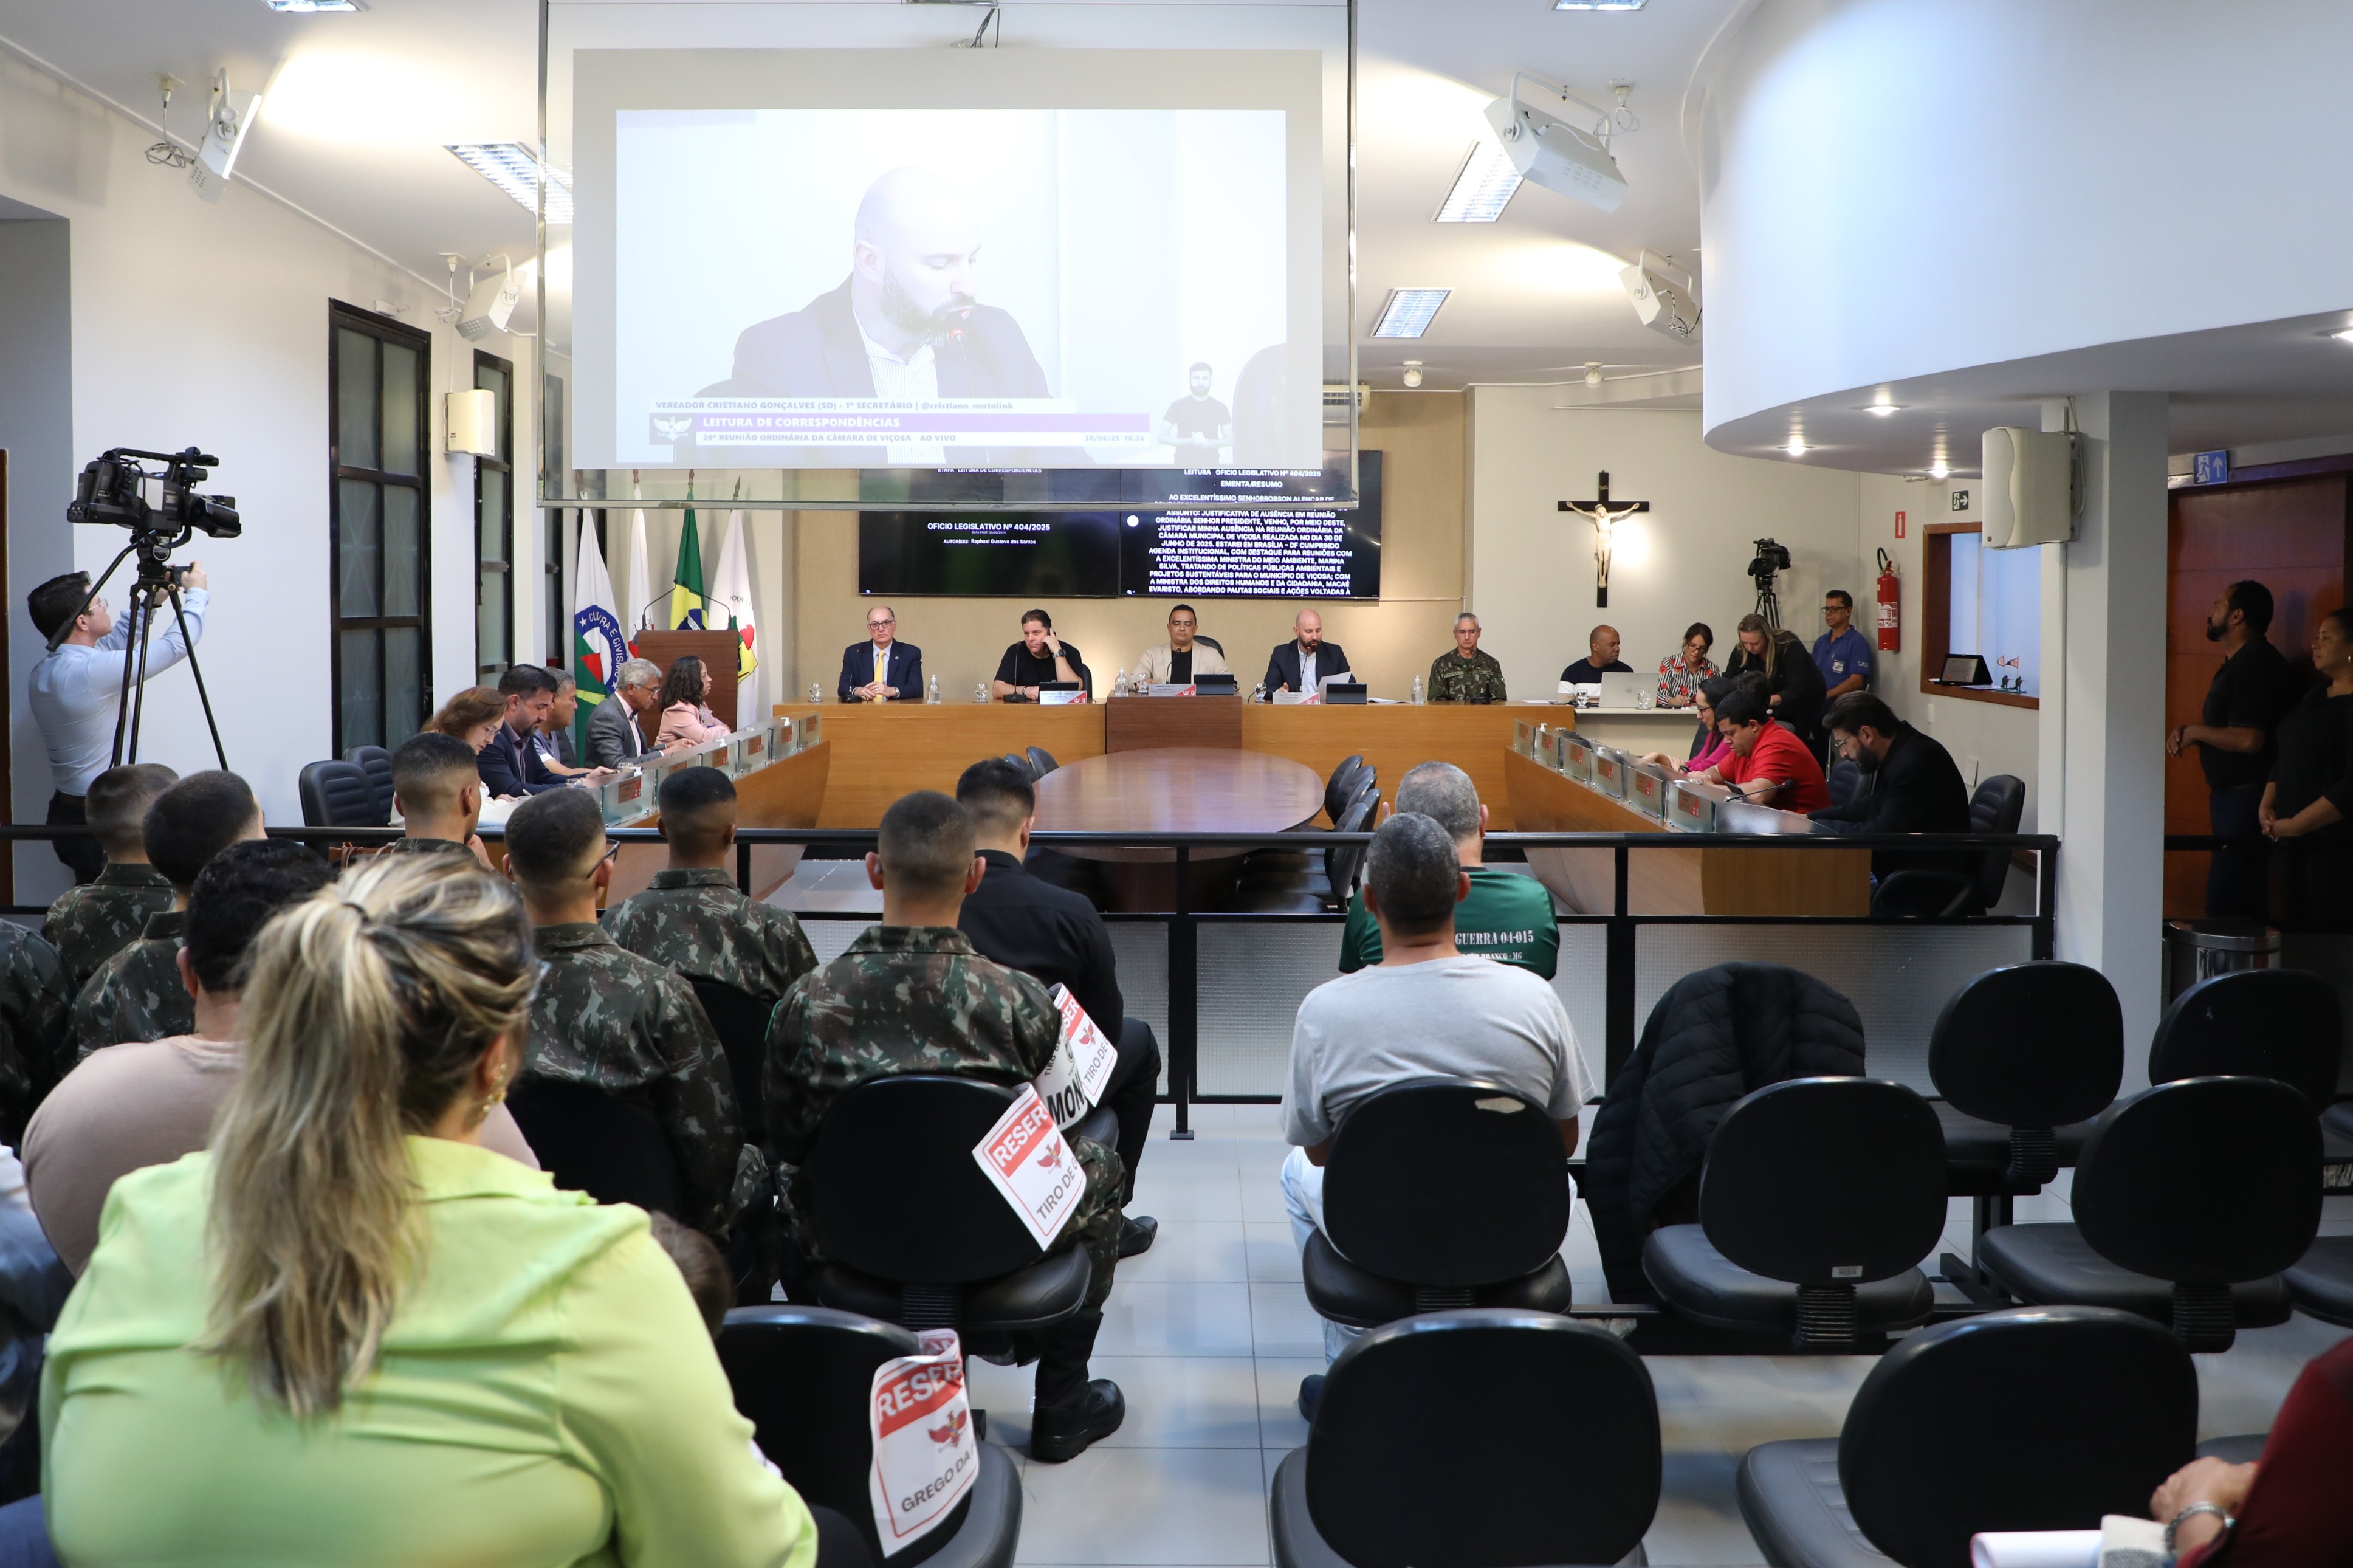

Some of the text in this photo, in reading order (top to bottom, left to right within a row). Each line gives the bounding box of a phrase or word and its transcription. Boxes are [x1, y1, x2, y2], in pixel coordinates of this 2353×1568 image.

[760, 402, 815, 411] GONÇALVES
[818, 402, 836, 410] (SD)
[856, 401, 913, 409] SECRETÁRIO
[702, 416, 900, 427] LEITURA DE CORRESPONDÊNCIAS
[719, 433, 757, 441] REUNIÃO
[760, 433, 808, 441] ORDINÁRIA
[826, 433, 864, 441] CÂMARA
[1155, 515, 1192, 524] ORDINÁRIA
[1221, 524, 1254, 532] AUSÊNCIA
[1266, 524, 1296, 533] REUNIÃO
[1163, 554, 1218, 562] EXCELENTÍSSIMA
[1228, 562, 1261, 571] POLÍTICAS
[1185, 569, 1234, 578] SUSTENTÁVEIS
[1286, 586, 1309, 595] AÇÕES
[610, 628, 617, 638] E
[1455, 930, 1534, 945] GUERRA 04-015
[1084, 1057, 1101, 1084] TIRO
[1098, 1044, 1108, 1059] DE
[992, 1101, 1049, 1167] RESER
[1036, 1167, 1076, 1219] TIRO DE
[901, 1450, 970, 1512] GREGO DA
